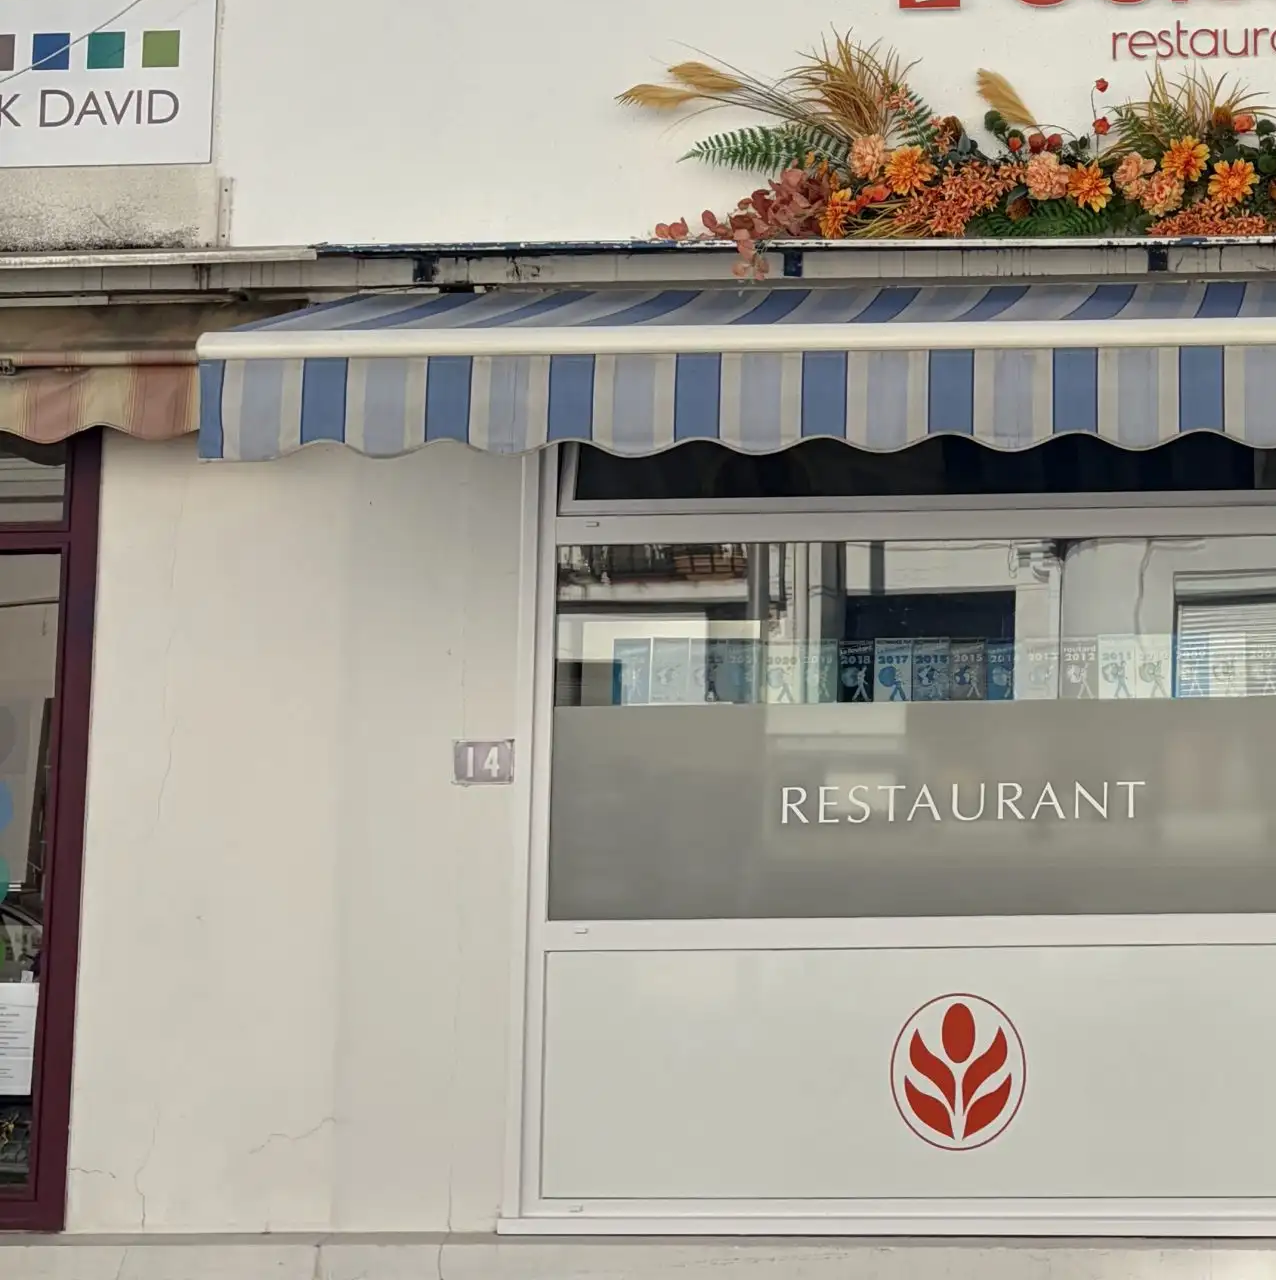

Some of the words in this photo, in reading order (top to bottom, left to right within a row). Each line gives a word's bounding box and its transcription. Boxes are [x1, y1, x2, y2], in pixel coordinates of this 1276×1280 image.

[39, 89, 180, 128] DAVID
[840, 655, 872, 665] 2018
[878, 655, 908, 664] 2017
[953, 654, 983, 662] 2015
[1064, 652, 1096, 661] 2012
[466, 745, 500, 778] 14
[781, 781, 1146, 824] RESTAURANT
